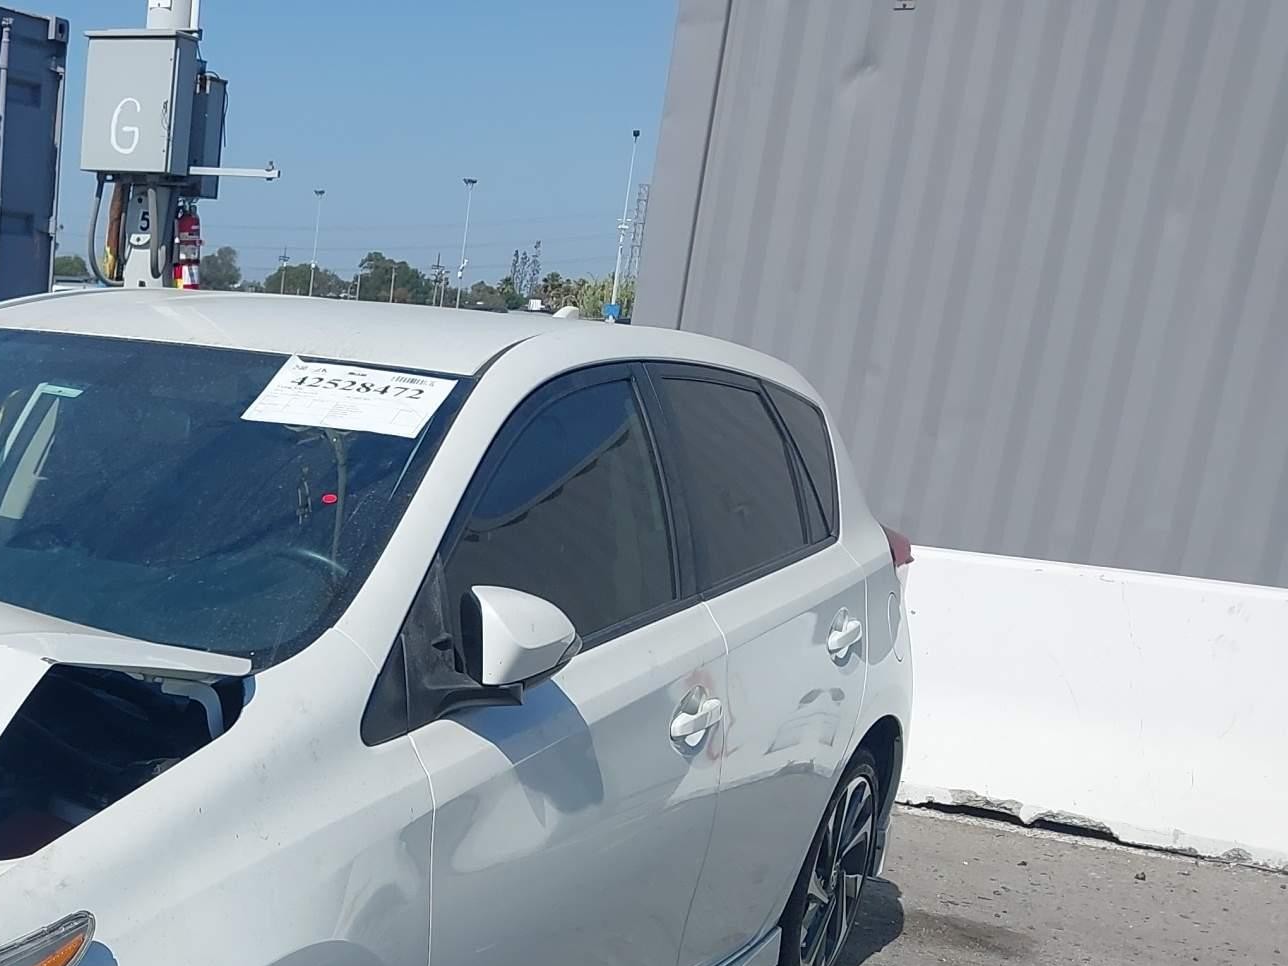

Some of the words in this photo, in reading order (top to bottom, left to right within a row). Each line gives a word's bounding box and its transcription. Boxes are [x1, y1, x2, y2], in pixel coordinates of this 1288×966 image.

[110, 97, 140, 154] G
[139, 211, 150, 231] 5
[291, 375, 425, 400] 42528472
